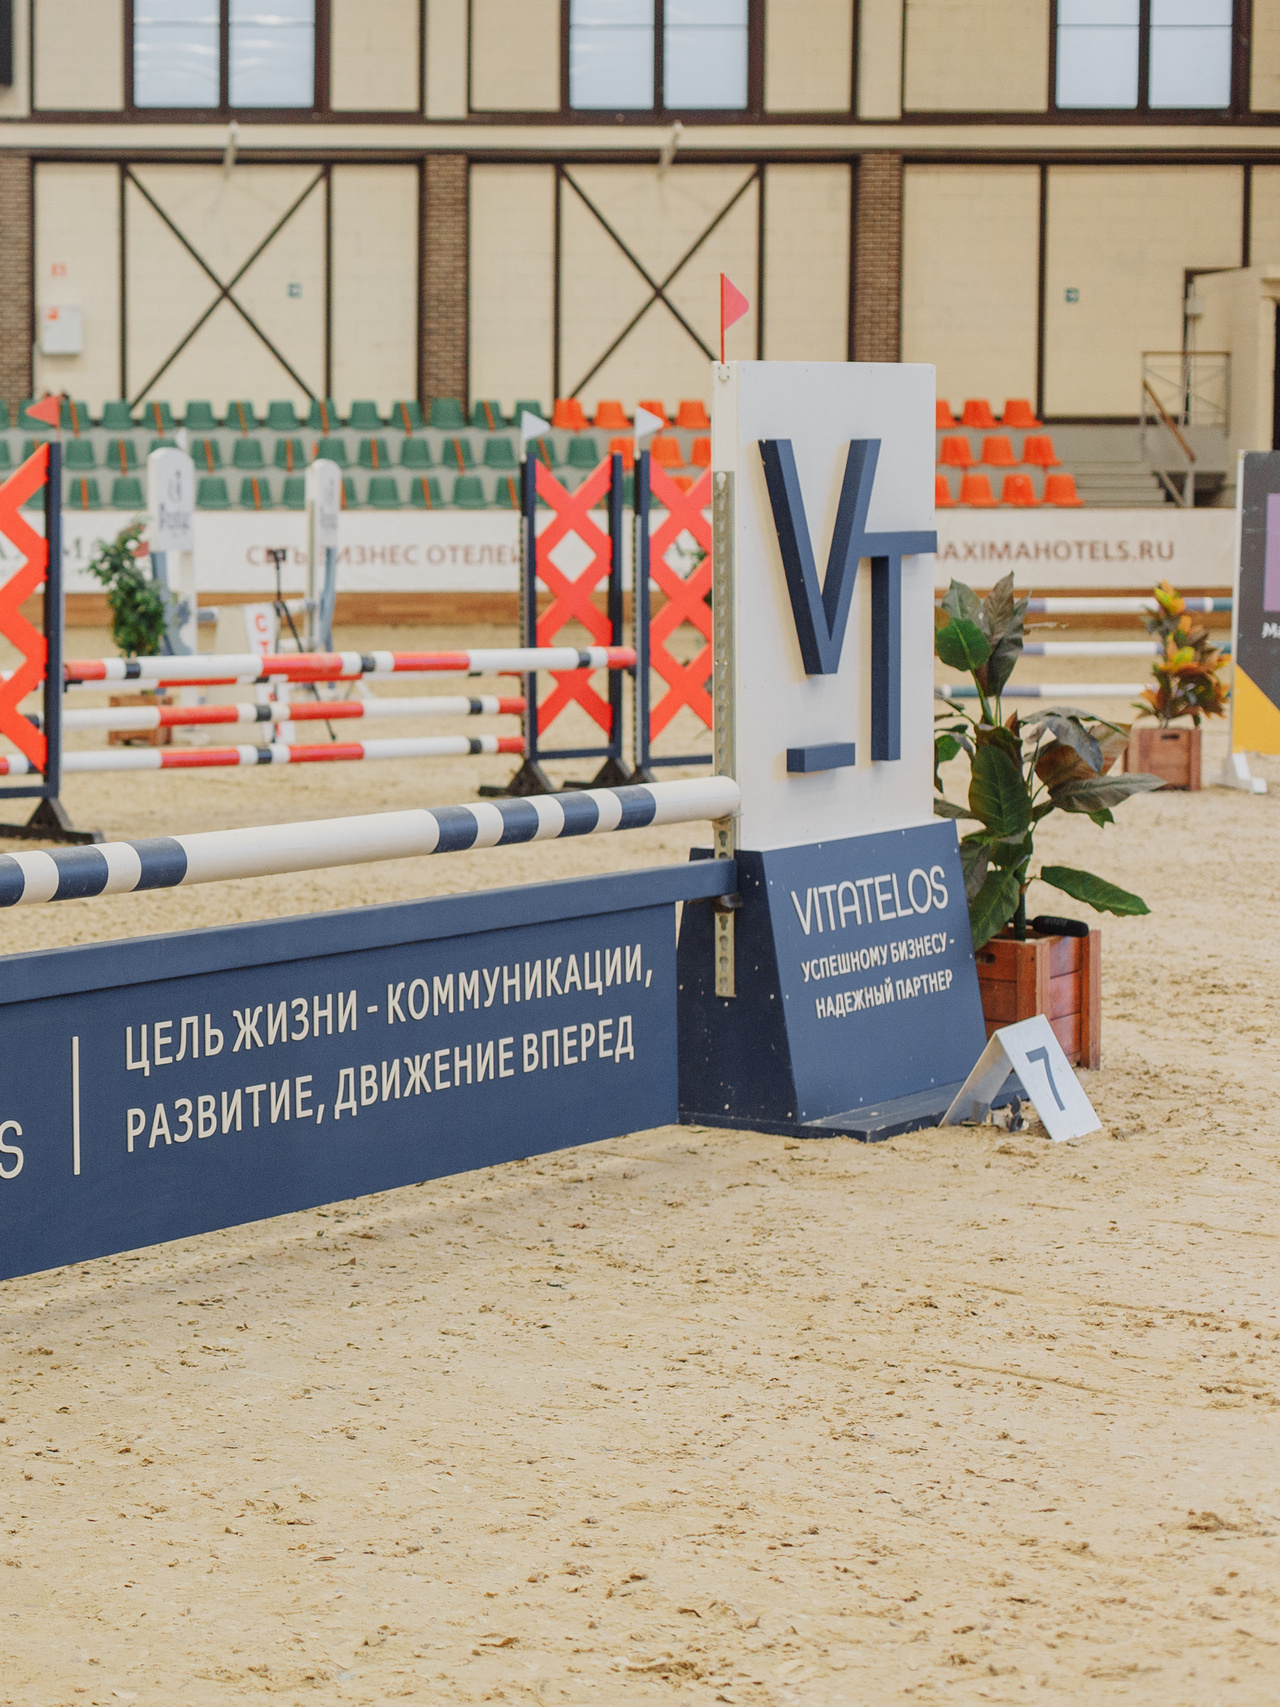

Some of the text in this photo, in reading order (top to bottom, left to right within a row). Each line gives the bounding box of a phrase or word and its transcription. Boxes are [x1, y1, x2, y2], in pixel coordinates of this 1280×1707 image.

[790, 865, 949, 936] VITATELOS
[801, 945, 888, 983] УСПЕШНОМУ
[891, 932, 947, 964] БИЗНЕСУ
[125, 1013, 225, 1077] ЦЕЛЬ
[232, 989, 357, 1053] ЖИЗНИ
[387, 943, 653, 1025] КОММУНИКАЦИИ,
[815, 968, 953, 1020] НАДЕЖНЫЙ ПАРТНЕР
[127, 1015, 635, 1153] РАЗВИТИЕ, ДВИЖЕНИЕ ВПЕРЕД
[1025, 1045, 1066, 1112] 7
